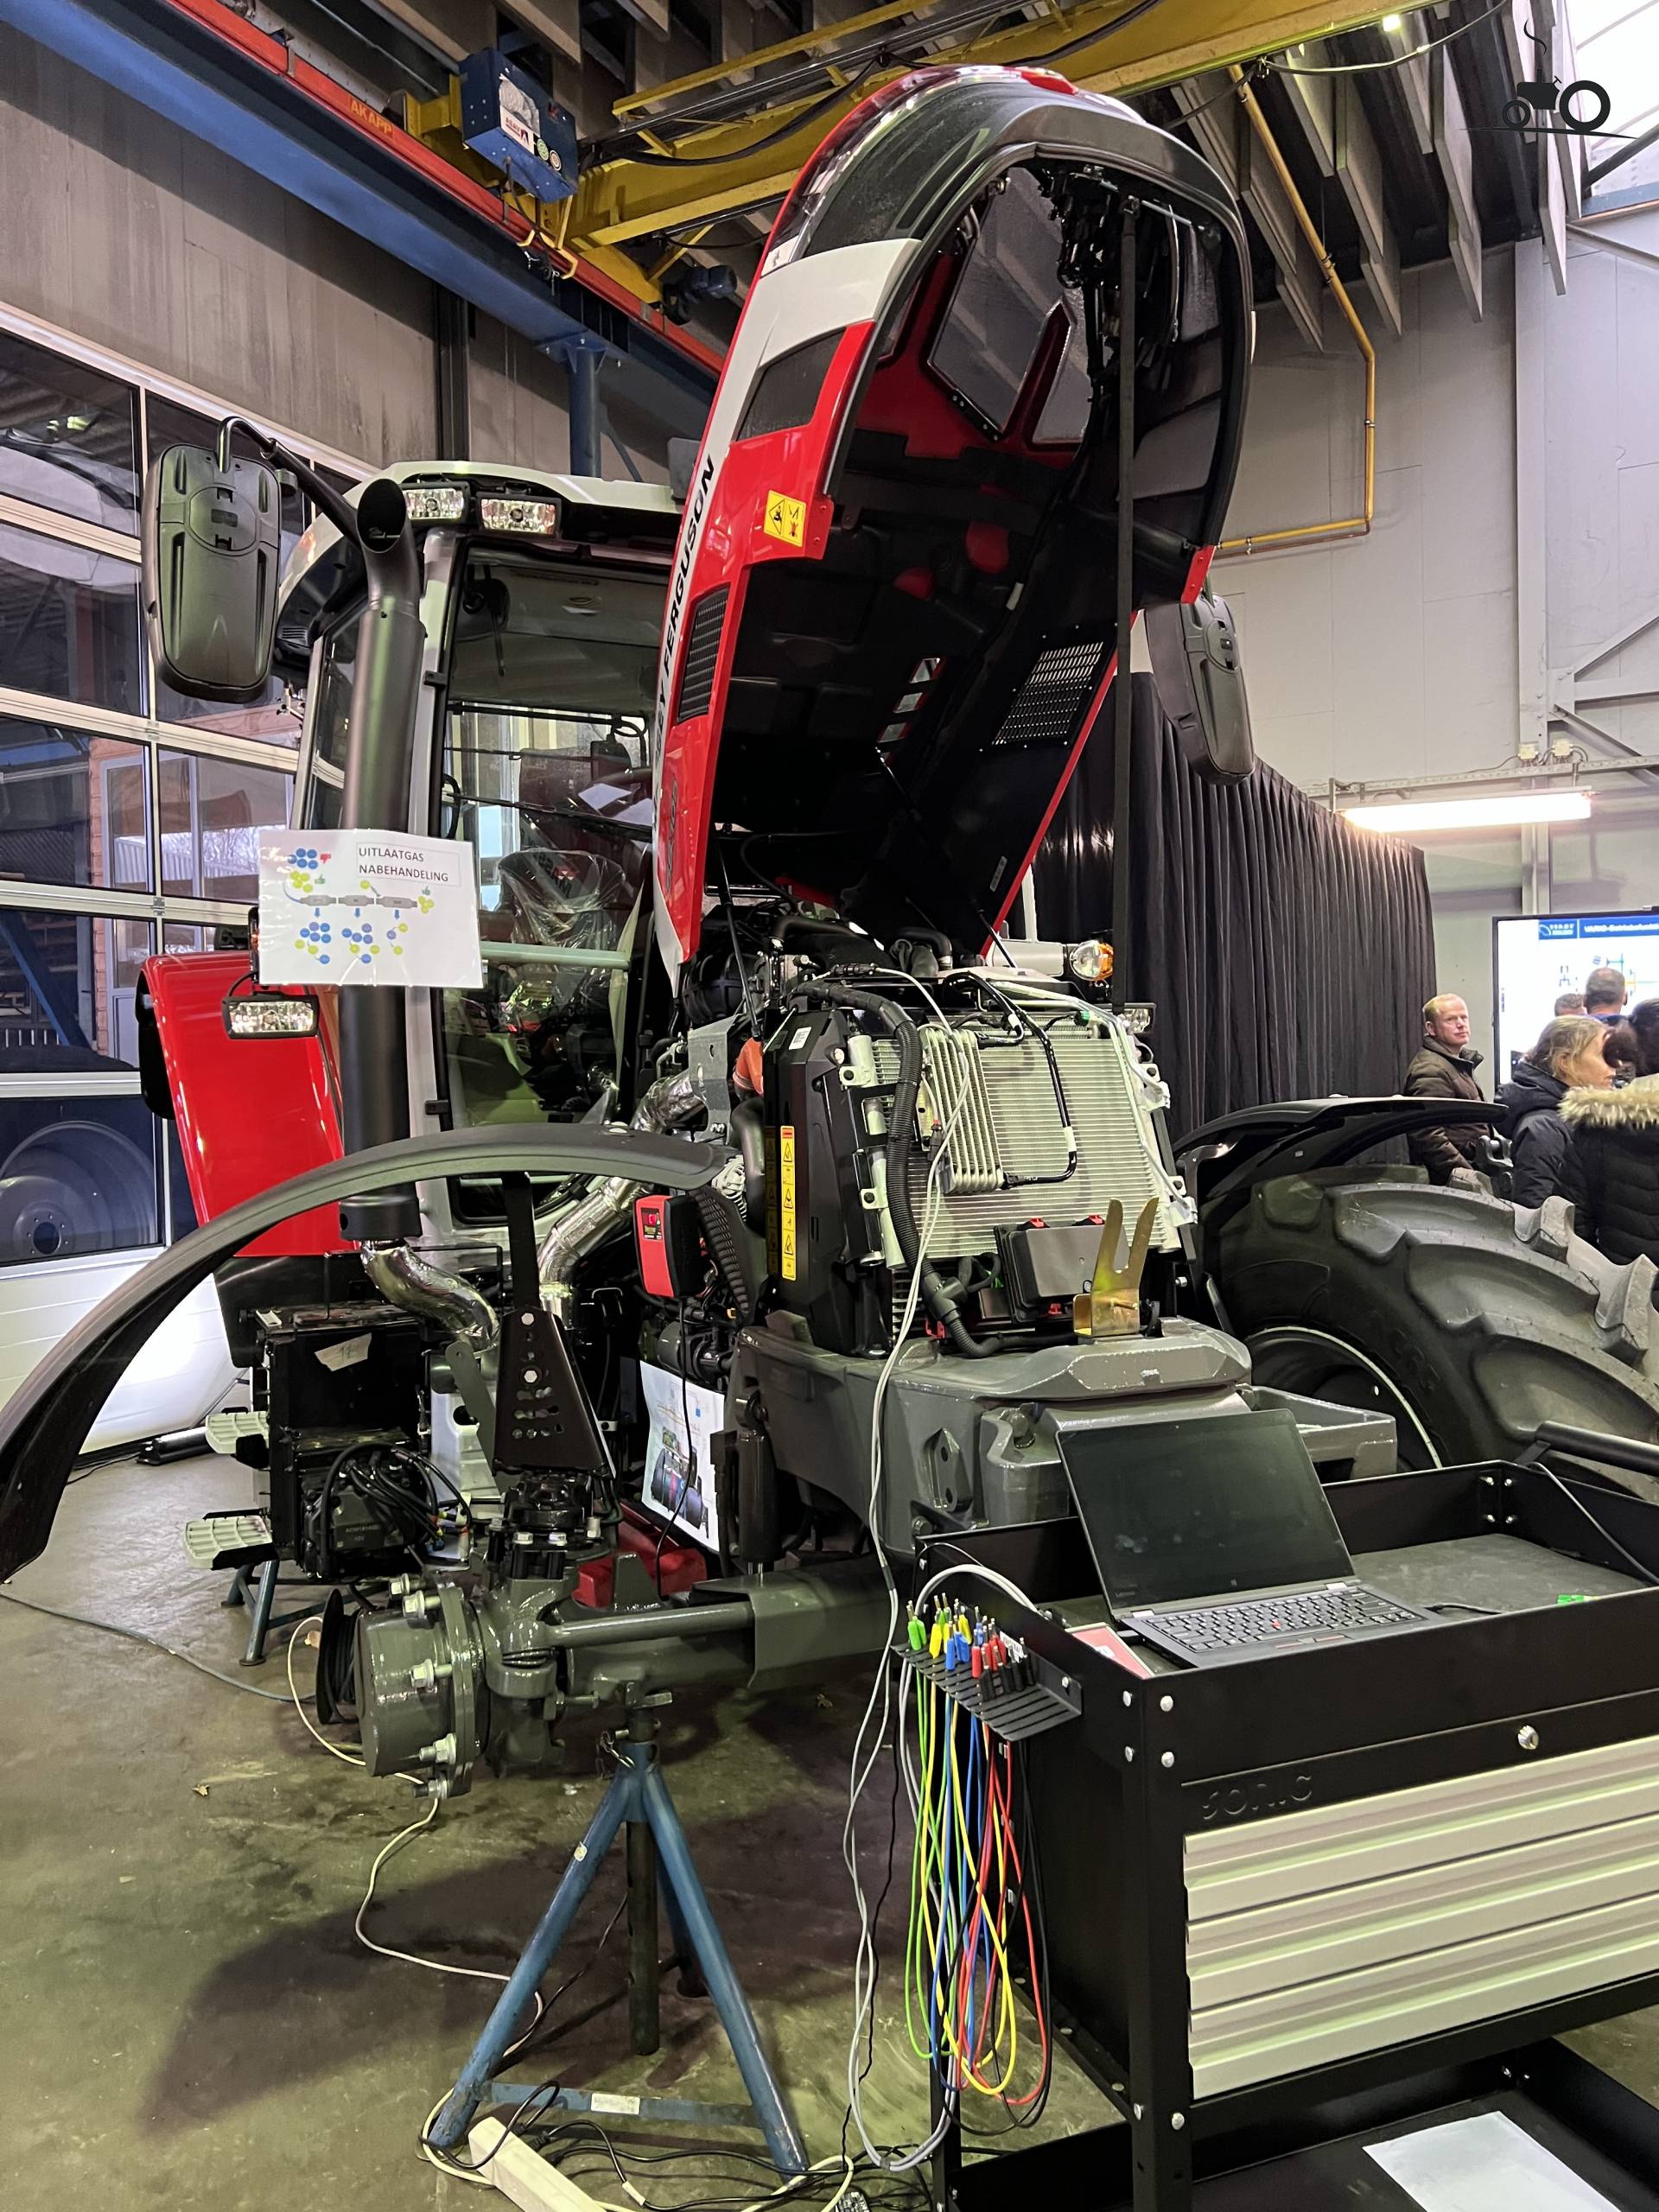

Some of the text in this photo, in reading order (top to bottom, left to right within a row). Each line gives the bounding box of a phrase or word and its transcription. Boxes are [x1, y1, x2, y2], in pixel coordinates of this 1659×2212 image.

[664, 454, 715, 677] FERGUSON
[359, 847, 424, 862] UITLAATGAS
[359, 864, 448, 882] NABEHANDELING
